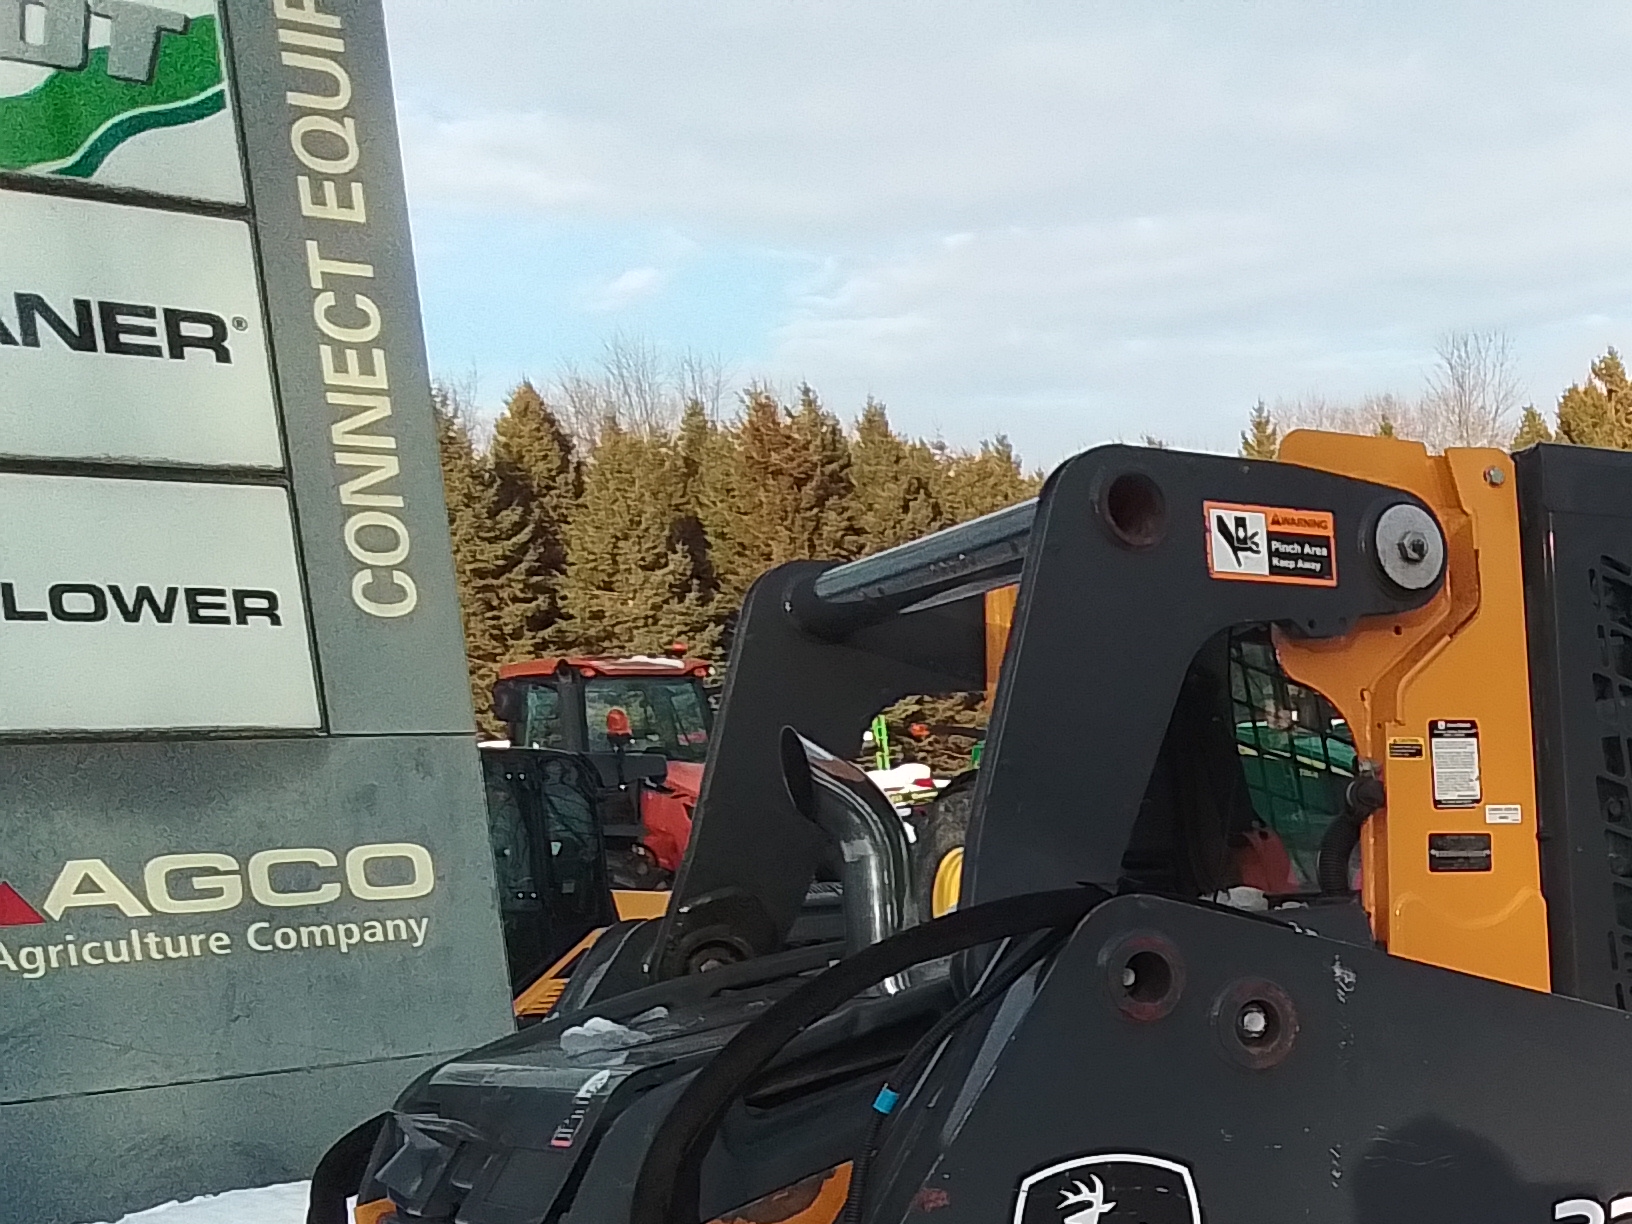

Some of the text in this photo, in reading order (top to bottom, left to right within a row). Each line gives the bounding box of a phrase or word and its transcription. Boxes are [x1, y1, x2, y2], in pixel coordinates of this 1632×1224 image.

[305, 239, 418, 618] CONNECT
[1279, 515, 1329, 530] WARNING
[1271, 540, 1328, 557] Pinch Area
[1271, 556, 1321, 572] Keep Away
[43, 842, 436, 922] AGCO
[246, 916, 430, 954] Company
